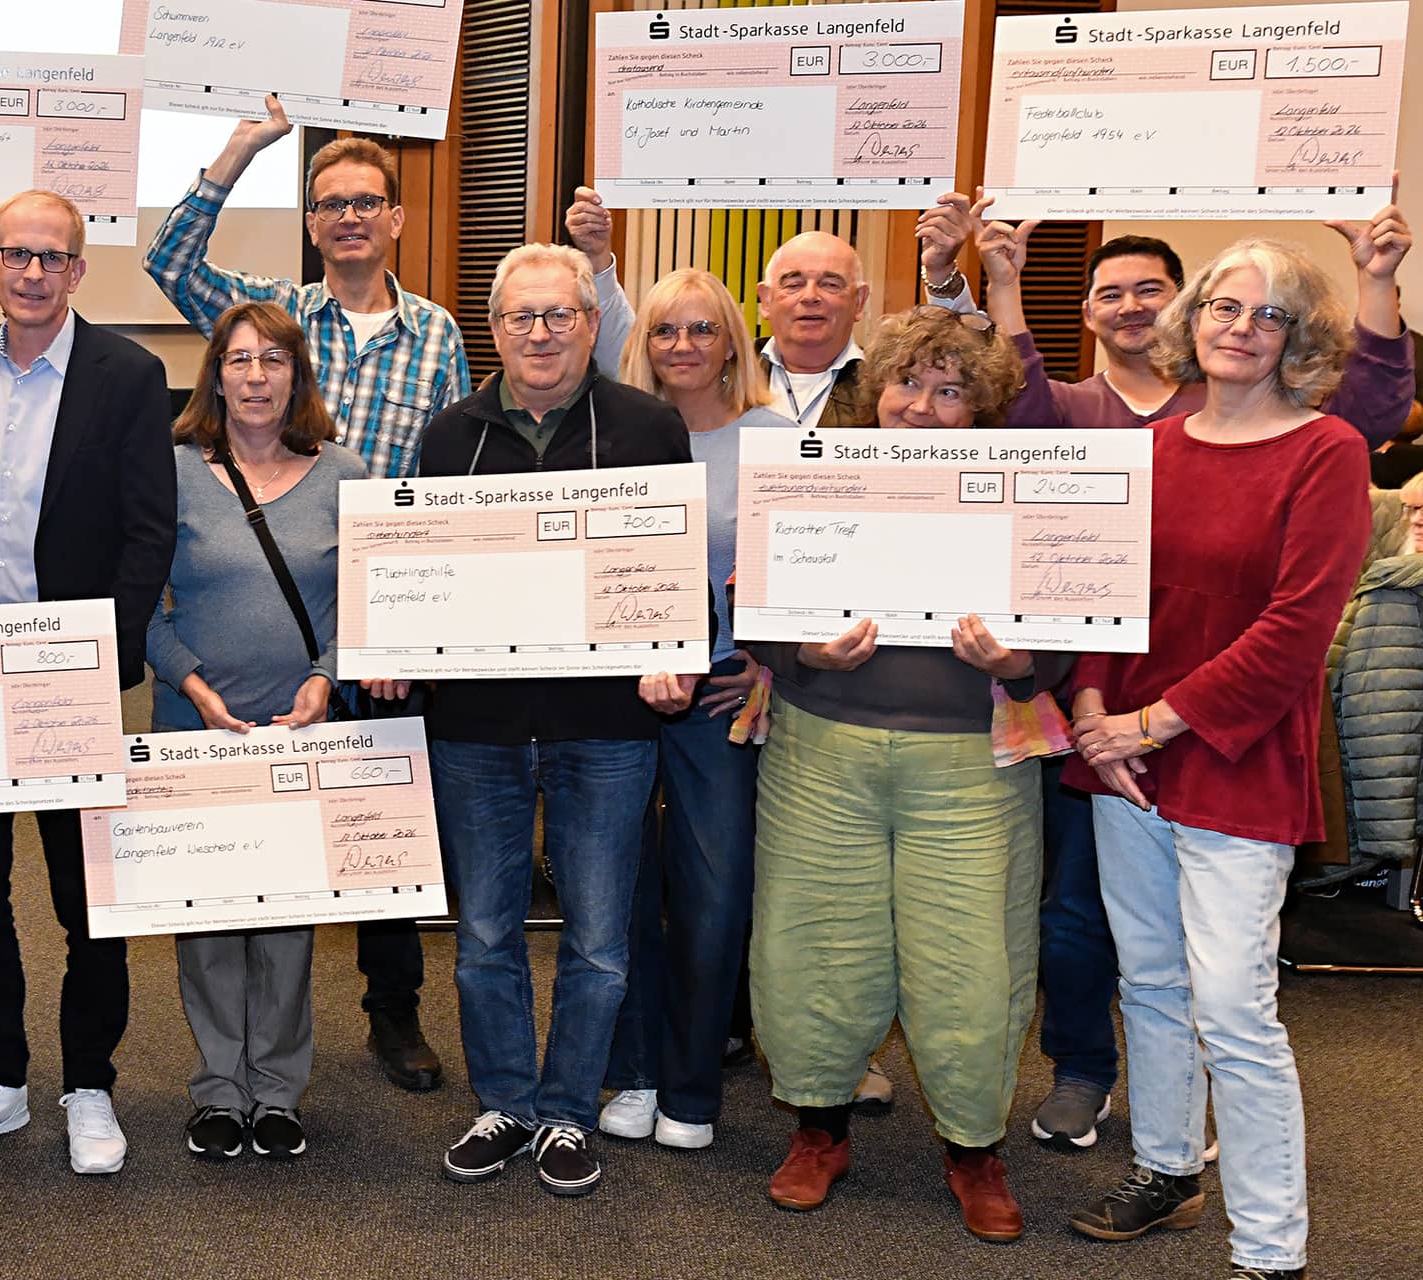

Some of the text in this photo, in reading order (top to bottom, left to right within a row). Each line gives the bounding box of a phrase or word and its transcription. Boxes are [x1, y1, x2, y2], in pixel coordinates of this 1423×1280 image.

[818, 19, 904, 38] Langenfeld
[1242, 21, 1340, 40] Langenfeld
[798, 56, 823, 66] EUR
[1219, 60, 1248, 71] EUR
[0, 97, 23, 107] EUR
[709, 126, 750, 136] Martin
[1020, 128, 1082, 148] Langenfeld
[1092, 128, 1123, 140] 1954
[989, 445, 1086, 464] Langenfeld
[563, 482, 647, 502] Langenfeld
[967, 482, 996, 493] EUR
[544, 521, 569, 531] EUR
[370, 590, 426, 609] Langenfeld
[292, 735, 373, 754] Langenfeld
[278, 773, 303, 783] EUR
[114, 845, 177, 863] Langenfeld
